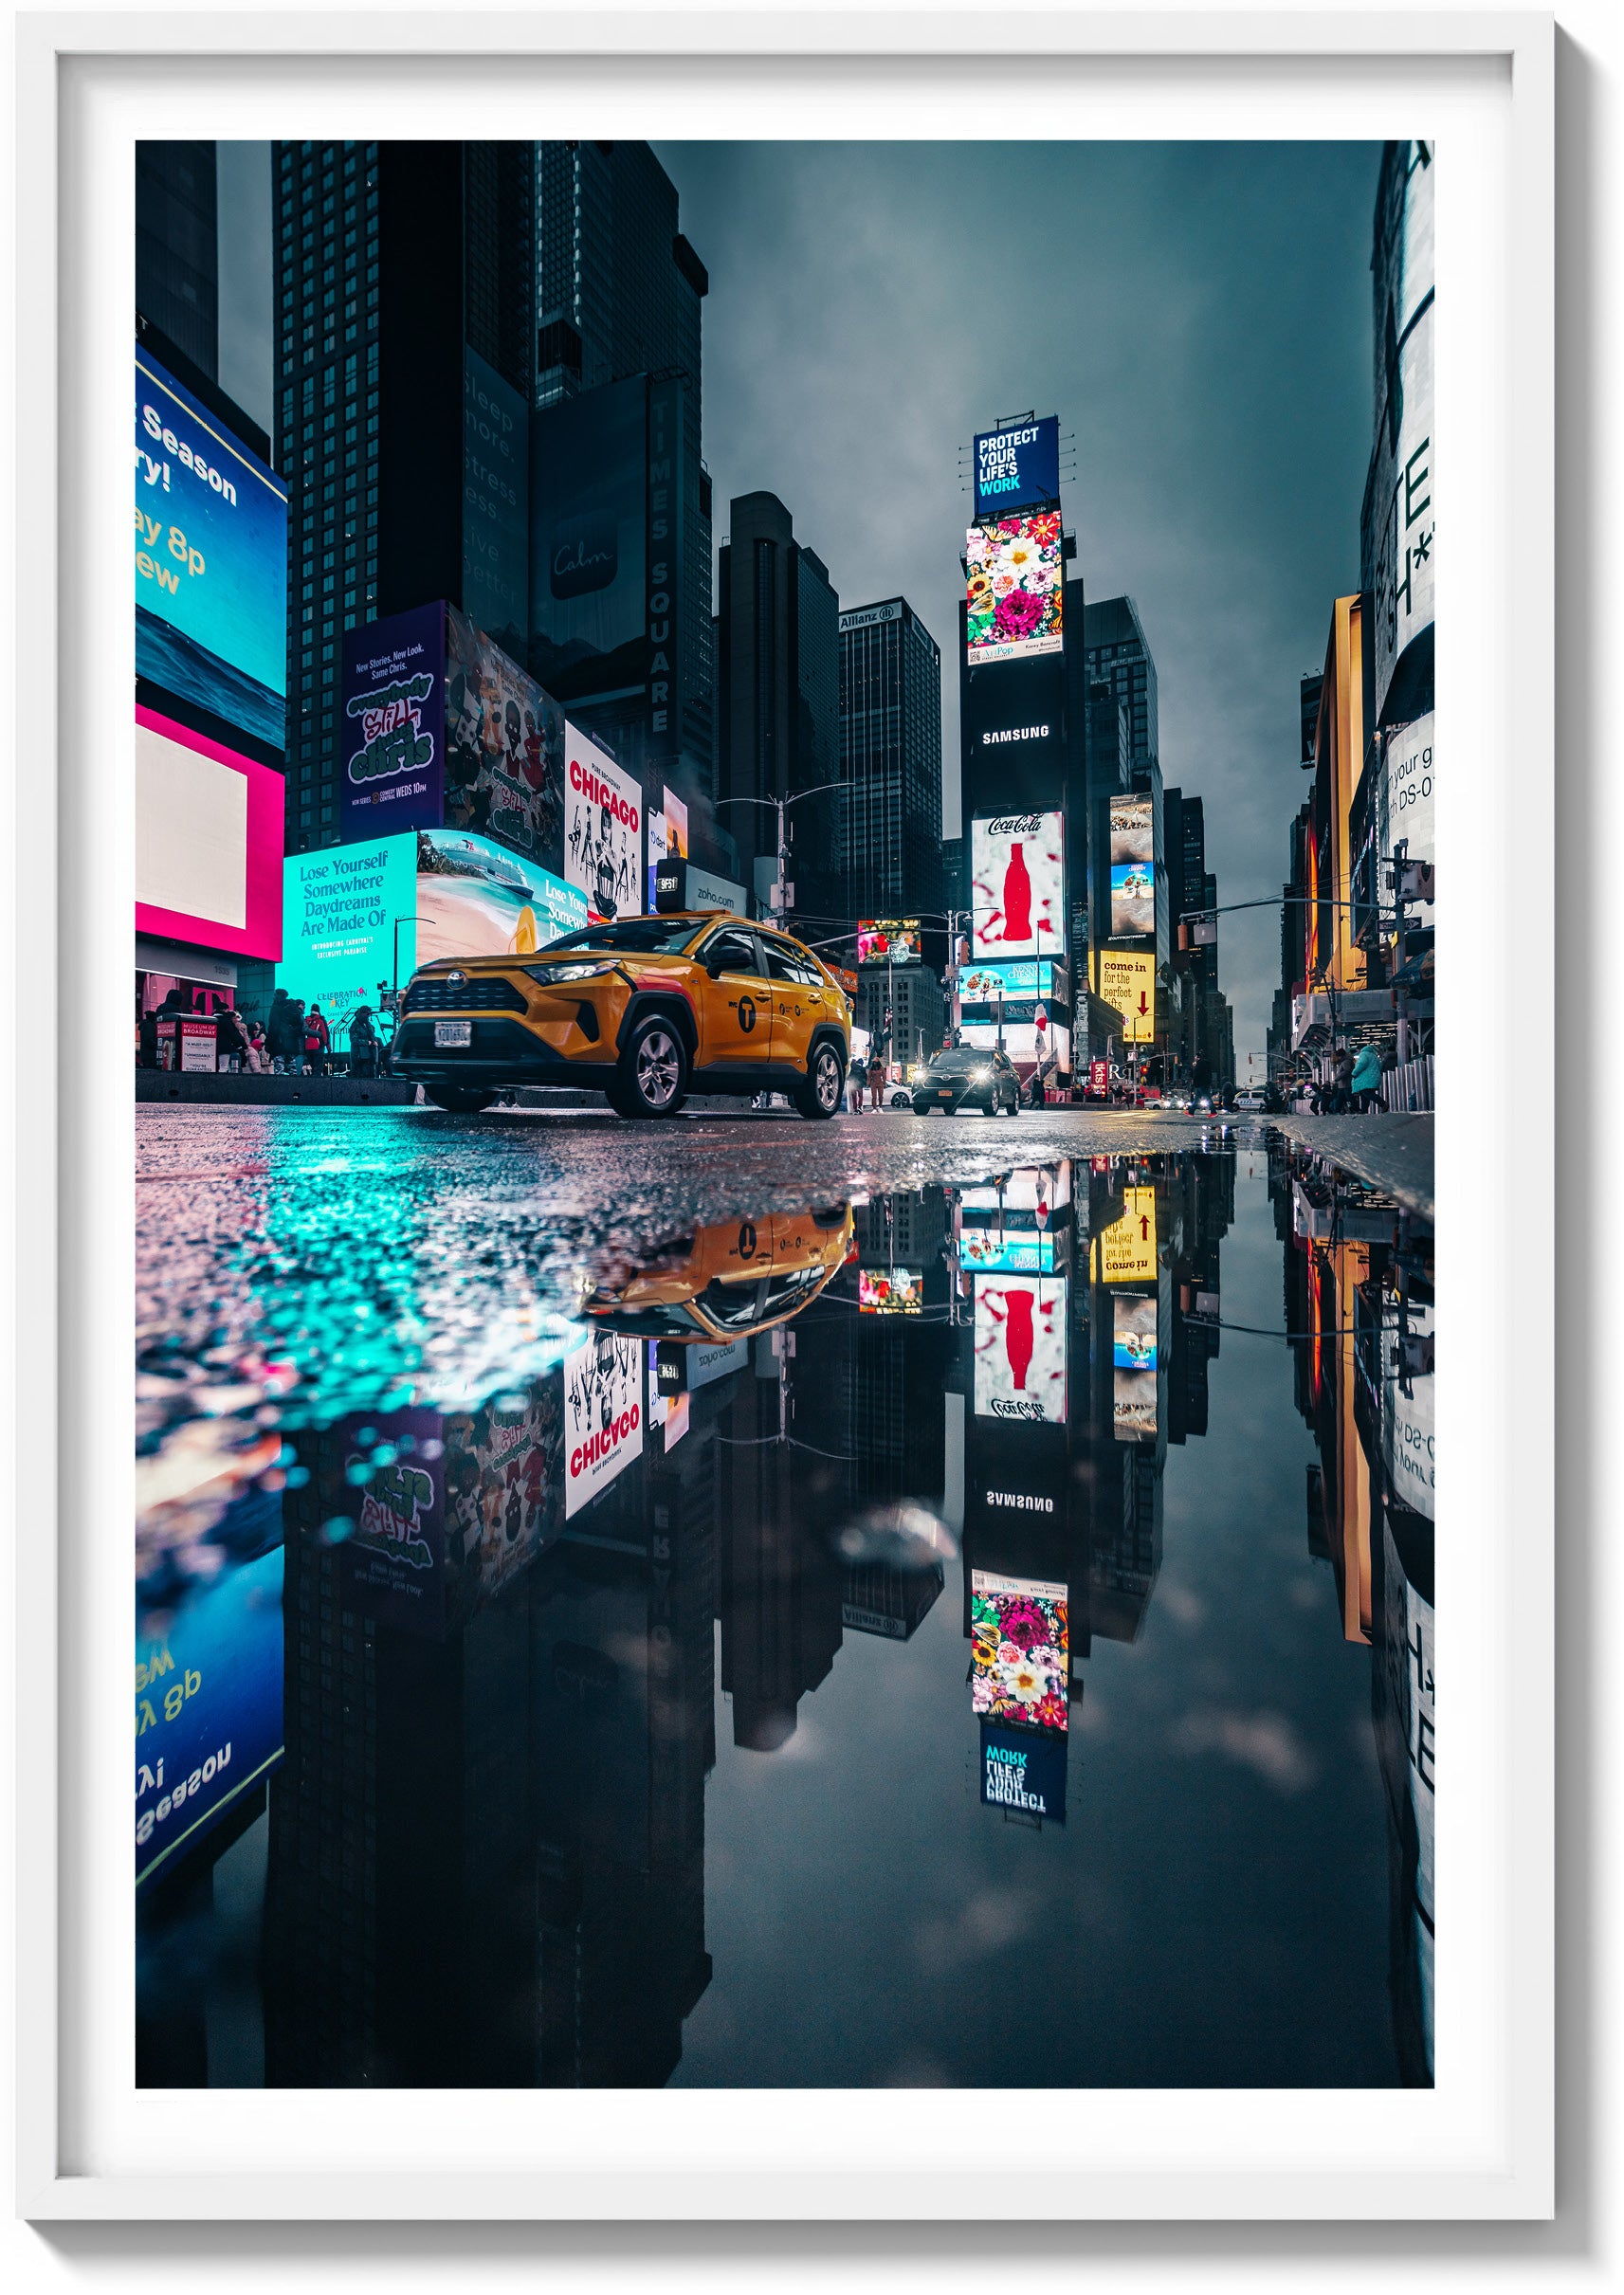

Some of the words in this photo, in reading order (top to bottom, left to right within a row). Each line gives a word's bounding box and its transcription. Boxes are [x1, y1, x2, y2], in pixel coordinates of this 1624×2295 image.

[979, 426, 1040, 455] PROTECT
[141, 404, 237, 507] Season
[978, 446, 1017, 468] YOUR
[979, 461, 1018, 483] LIFE'S
[979, 474, 1022, 497] WORK
[167, 525, 207, 578] 8p
[554, 539, 615, 576] Calm
[135, 551, 180, 596] ew
[841, 612, 879, 629] Allianz
[356, 663, 369, 675] New
[369, 653, 392, 670] Stories.
[393, 648, 407, 663] New
[407, 643, 425, 656] Look.
[372, 667, 389, 681] Same
[389, 662, 408, 674] Chris.
[649, 657, 672, 734] SQUARE
[982, 724, 1049, 745] SAMSUNG
[1395, 753, 1419, 791] your
[395, 787, 412, 801] WEDS
[570, 760, 639, 834] CHICAGO
[300, 865, 330, 883] Lose
[332, 849, 390, 876] Yourself
[303, 874, 385, 900] Somewhere
[545, 879, 567, 905] Lose
[697, 885, 735, 909] zoho.com
[304, 894, 381, 920] Daydreams
[301, 920, 325, 938] Are
[327, 913, 366, 934] Made
[367, 908, 387, 927] Of
[310, 939, 344, 951] INTRODUCING
[345, 936, 374, 947] CARNIVAL'S
[316, 949, 342, 960] EXCLUSIVE
[342, 946, 368, 956] PARADISE
[1104, 962, 1134, 973] come
[1134, 961, 1147, 973] in
[1104, 970, 1115, 984] for
[1116, 972, 1131, 986] the
[317, 988, 369, 1001] CELEBRATION
[335, 998, 350, 1010] KEY
[1104, 986, 1133, 1001] perfect
[1094, 1063, 1106, 1084] tkts
